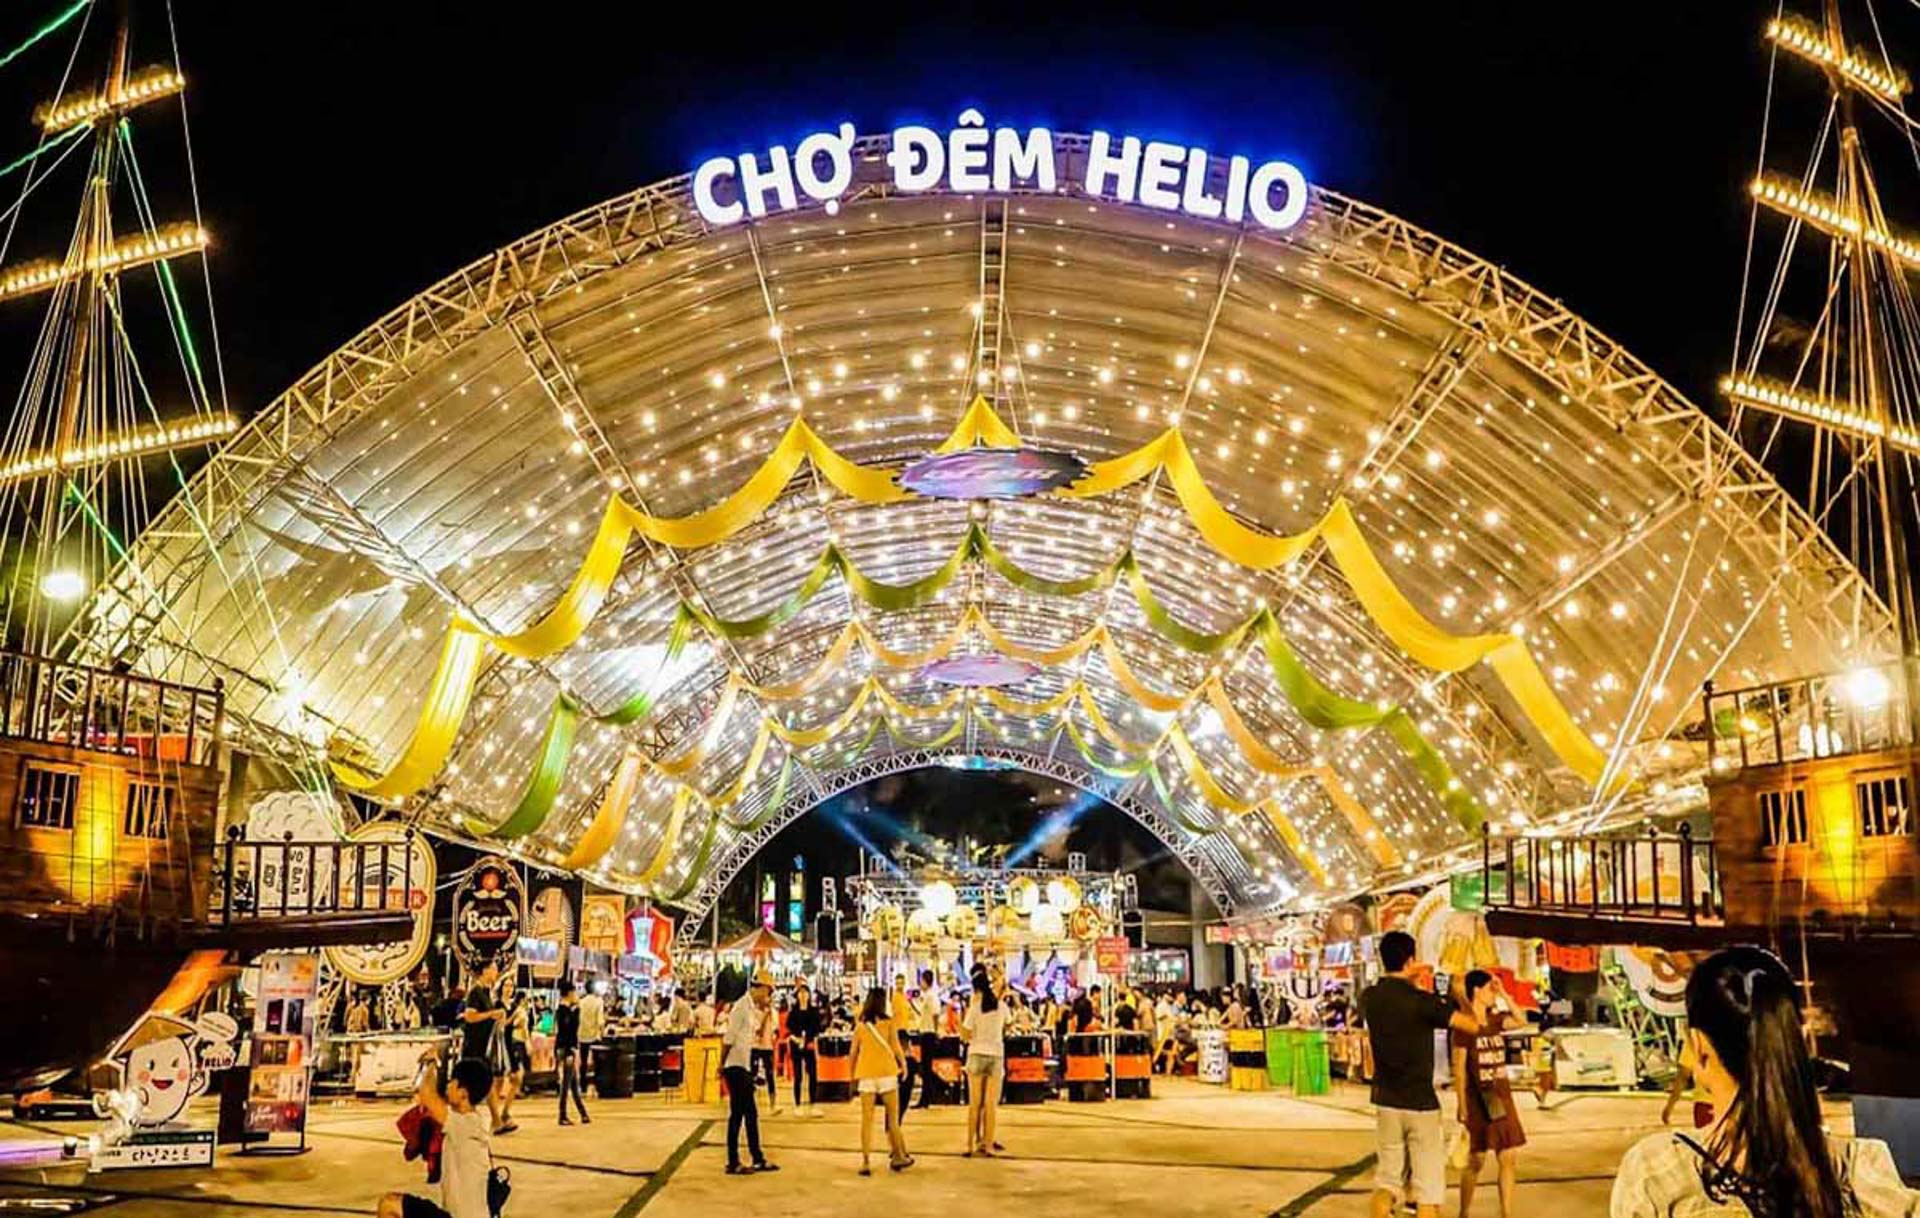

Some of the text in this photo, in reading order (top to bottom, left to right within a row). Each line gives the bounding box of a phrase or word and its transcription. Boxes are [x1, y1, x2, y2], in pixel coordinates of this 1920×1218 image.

[692, 108, 1308, 230] CHỢ ĐÊM HELIO
[467, 910, 512, 932] Beer
